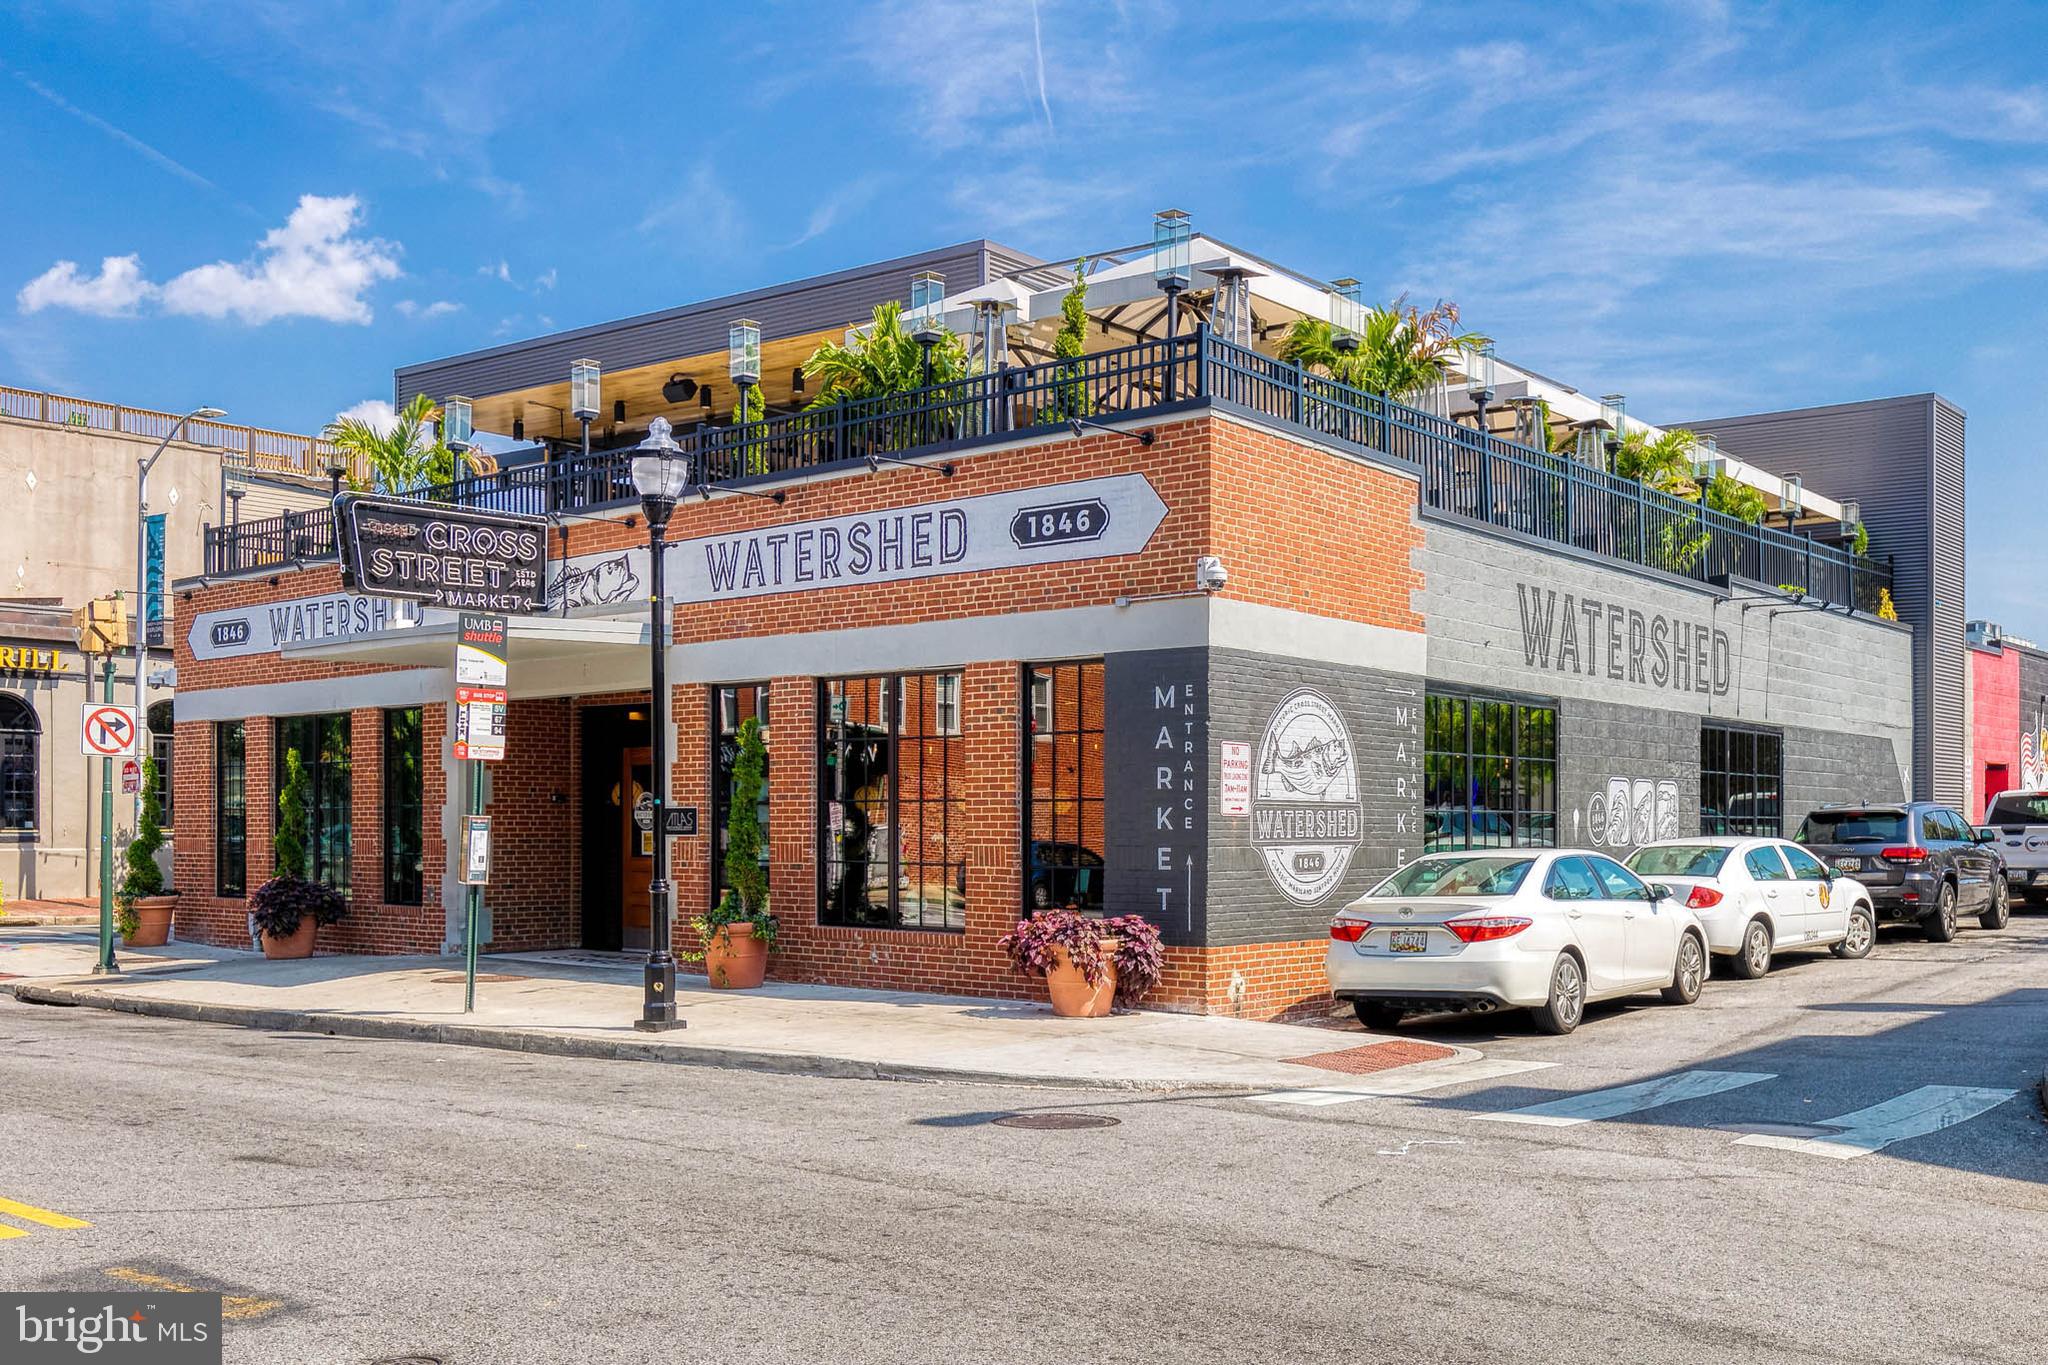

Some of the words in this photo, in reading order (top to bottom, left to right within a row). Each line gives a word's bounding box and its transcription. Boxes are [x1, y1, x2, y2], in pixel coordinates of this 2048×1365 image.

[1028, 509, 1090, 539] 1846
[425, 521, 537, 561] CROSS
[705, 508, 967, 592] WATERSHED
[371, 549, 507, 588] STREET
[448, 590, 522, 610] MARKET
[217, 627, 245, 642] 1846
[463, 630, 503, 644] shuttle
[464, 617, 492, 631] UMB
[1517, 583, 1731, 697] WATERSHED
[1184, 684, 1194, 829] ENTRANCE
[1223, 759, 1248, 770] PARKING
[1231, 746, 1240, 756] NO
[1155, 685, 1175, 911] MARKET
[1396, 706, 1408, 868] MARKE
[666, 812, 693, 827] ATLAS
[1256, 809, 1358, 839] WATERSHED
[1299, 857, 1320, 869] 1846
